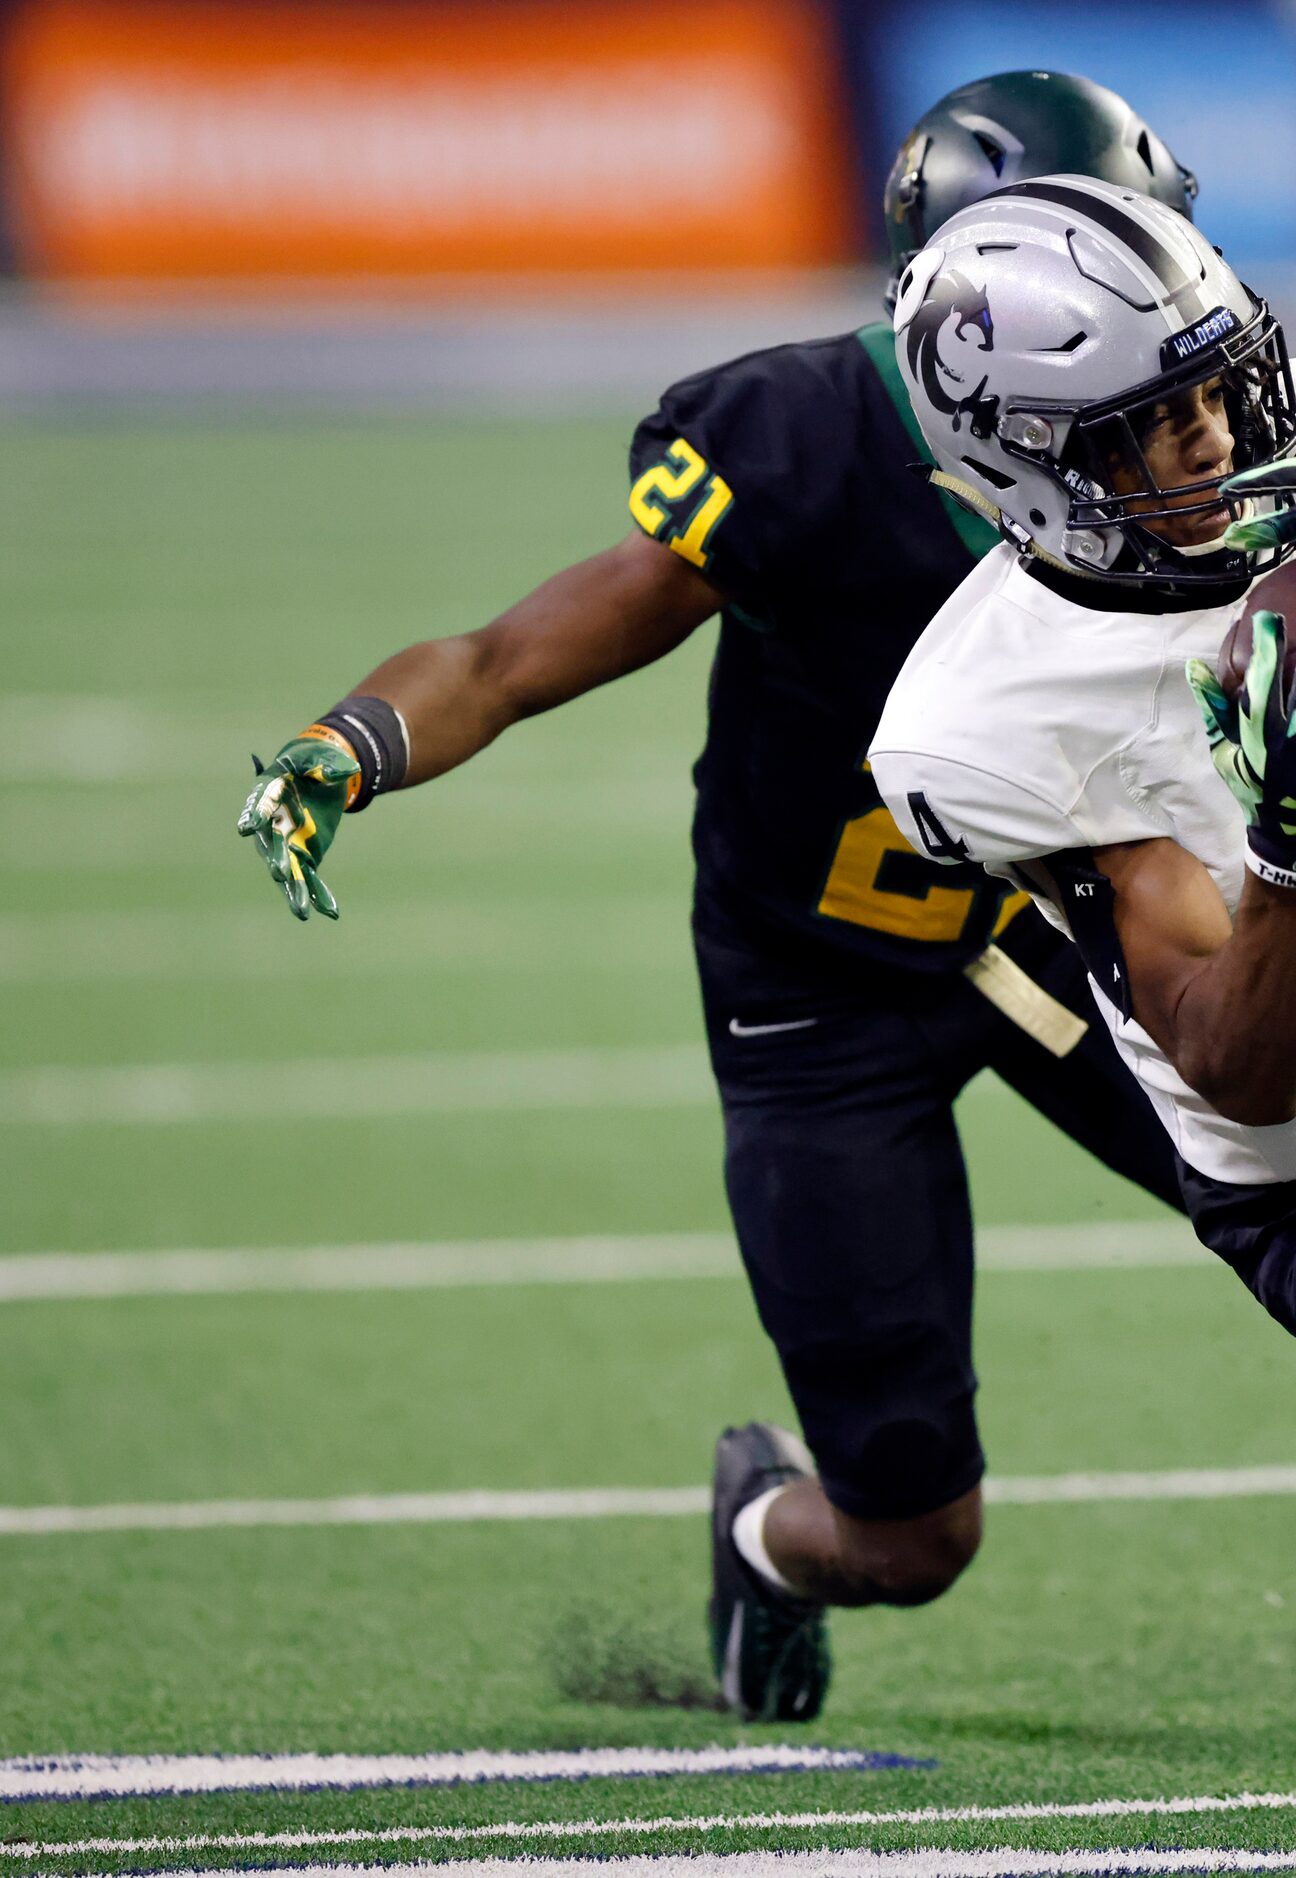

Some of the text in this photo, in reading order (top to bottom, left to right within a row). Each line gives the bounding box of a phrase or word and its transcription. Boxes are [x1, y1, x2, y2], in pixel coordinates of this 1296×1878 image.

[629, 437, 733, 568] 21
[907, 789, 971, 862] 4
[1074, 883, 1095, 897] KT
